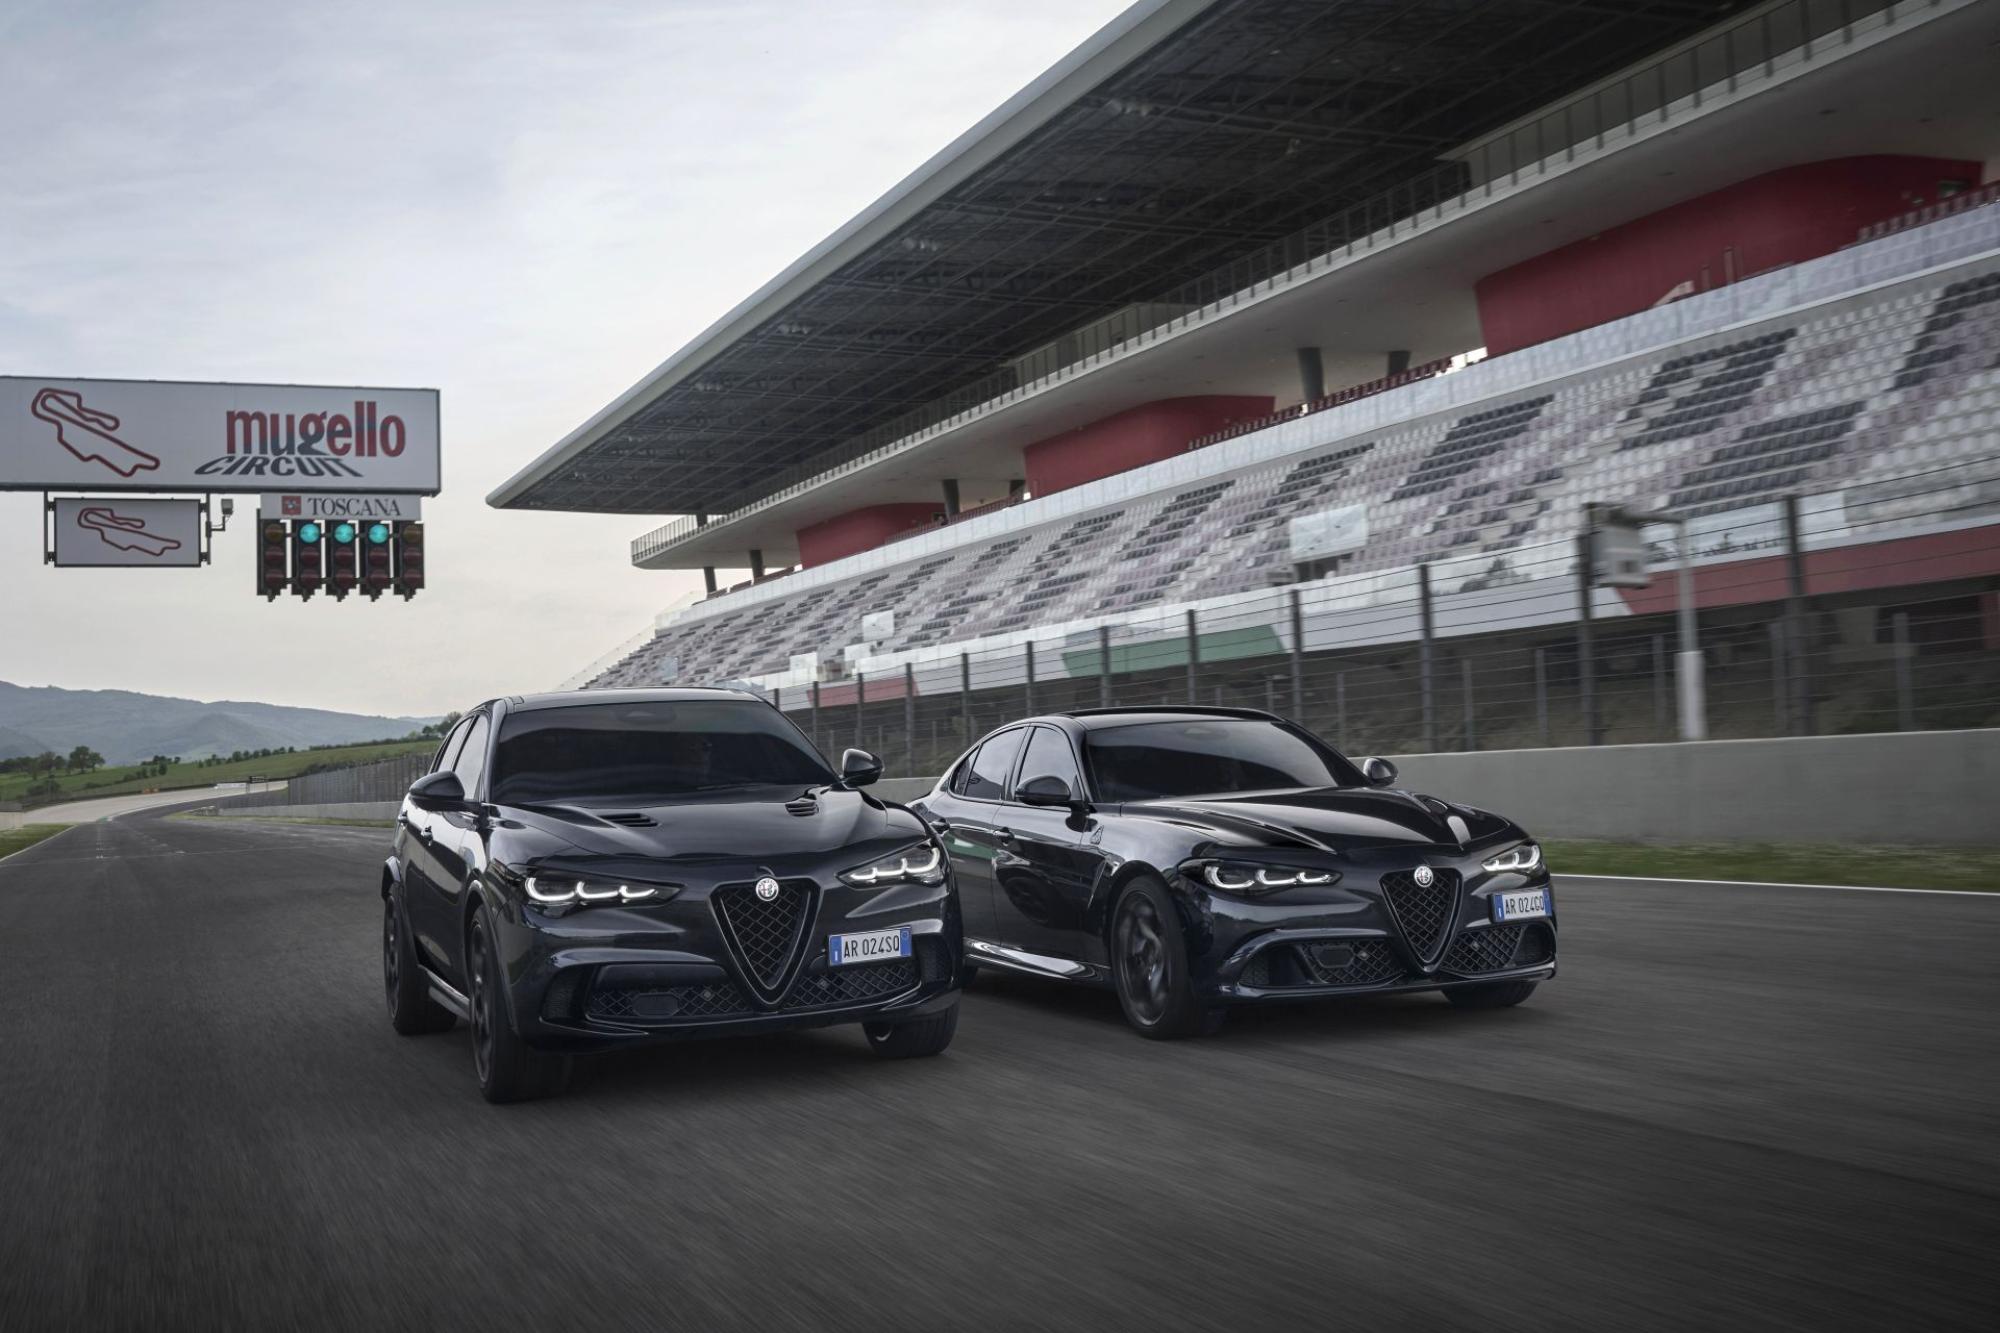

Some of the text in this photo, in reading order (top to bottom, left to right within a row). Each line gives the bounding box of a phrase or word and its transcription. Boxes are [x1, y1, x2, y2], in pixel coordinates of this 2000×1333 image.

[226, 400, 406, 457] mugello
[194, 455, 364, 477] CIRCUIT
[307, 497, 401, 516] TOSCANA
[1505, 898, 1516, 914] AR
[843, 940, 858, 958] AR
